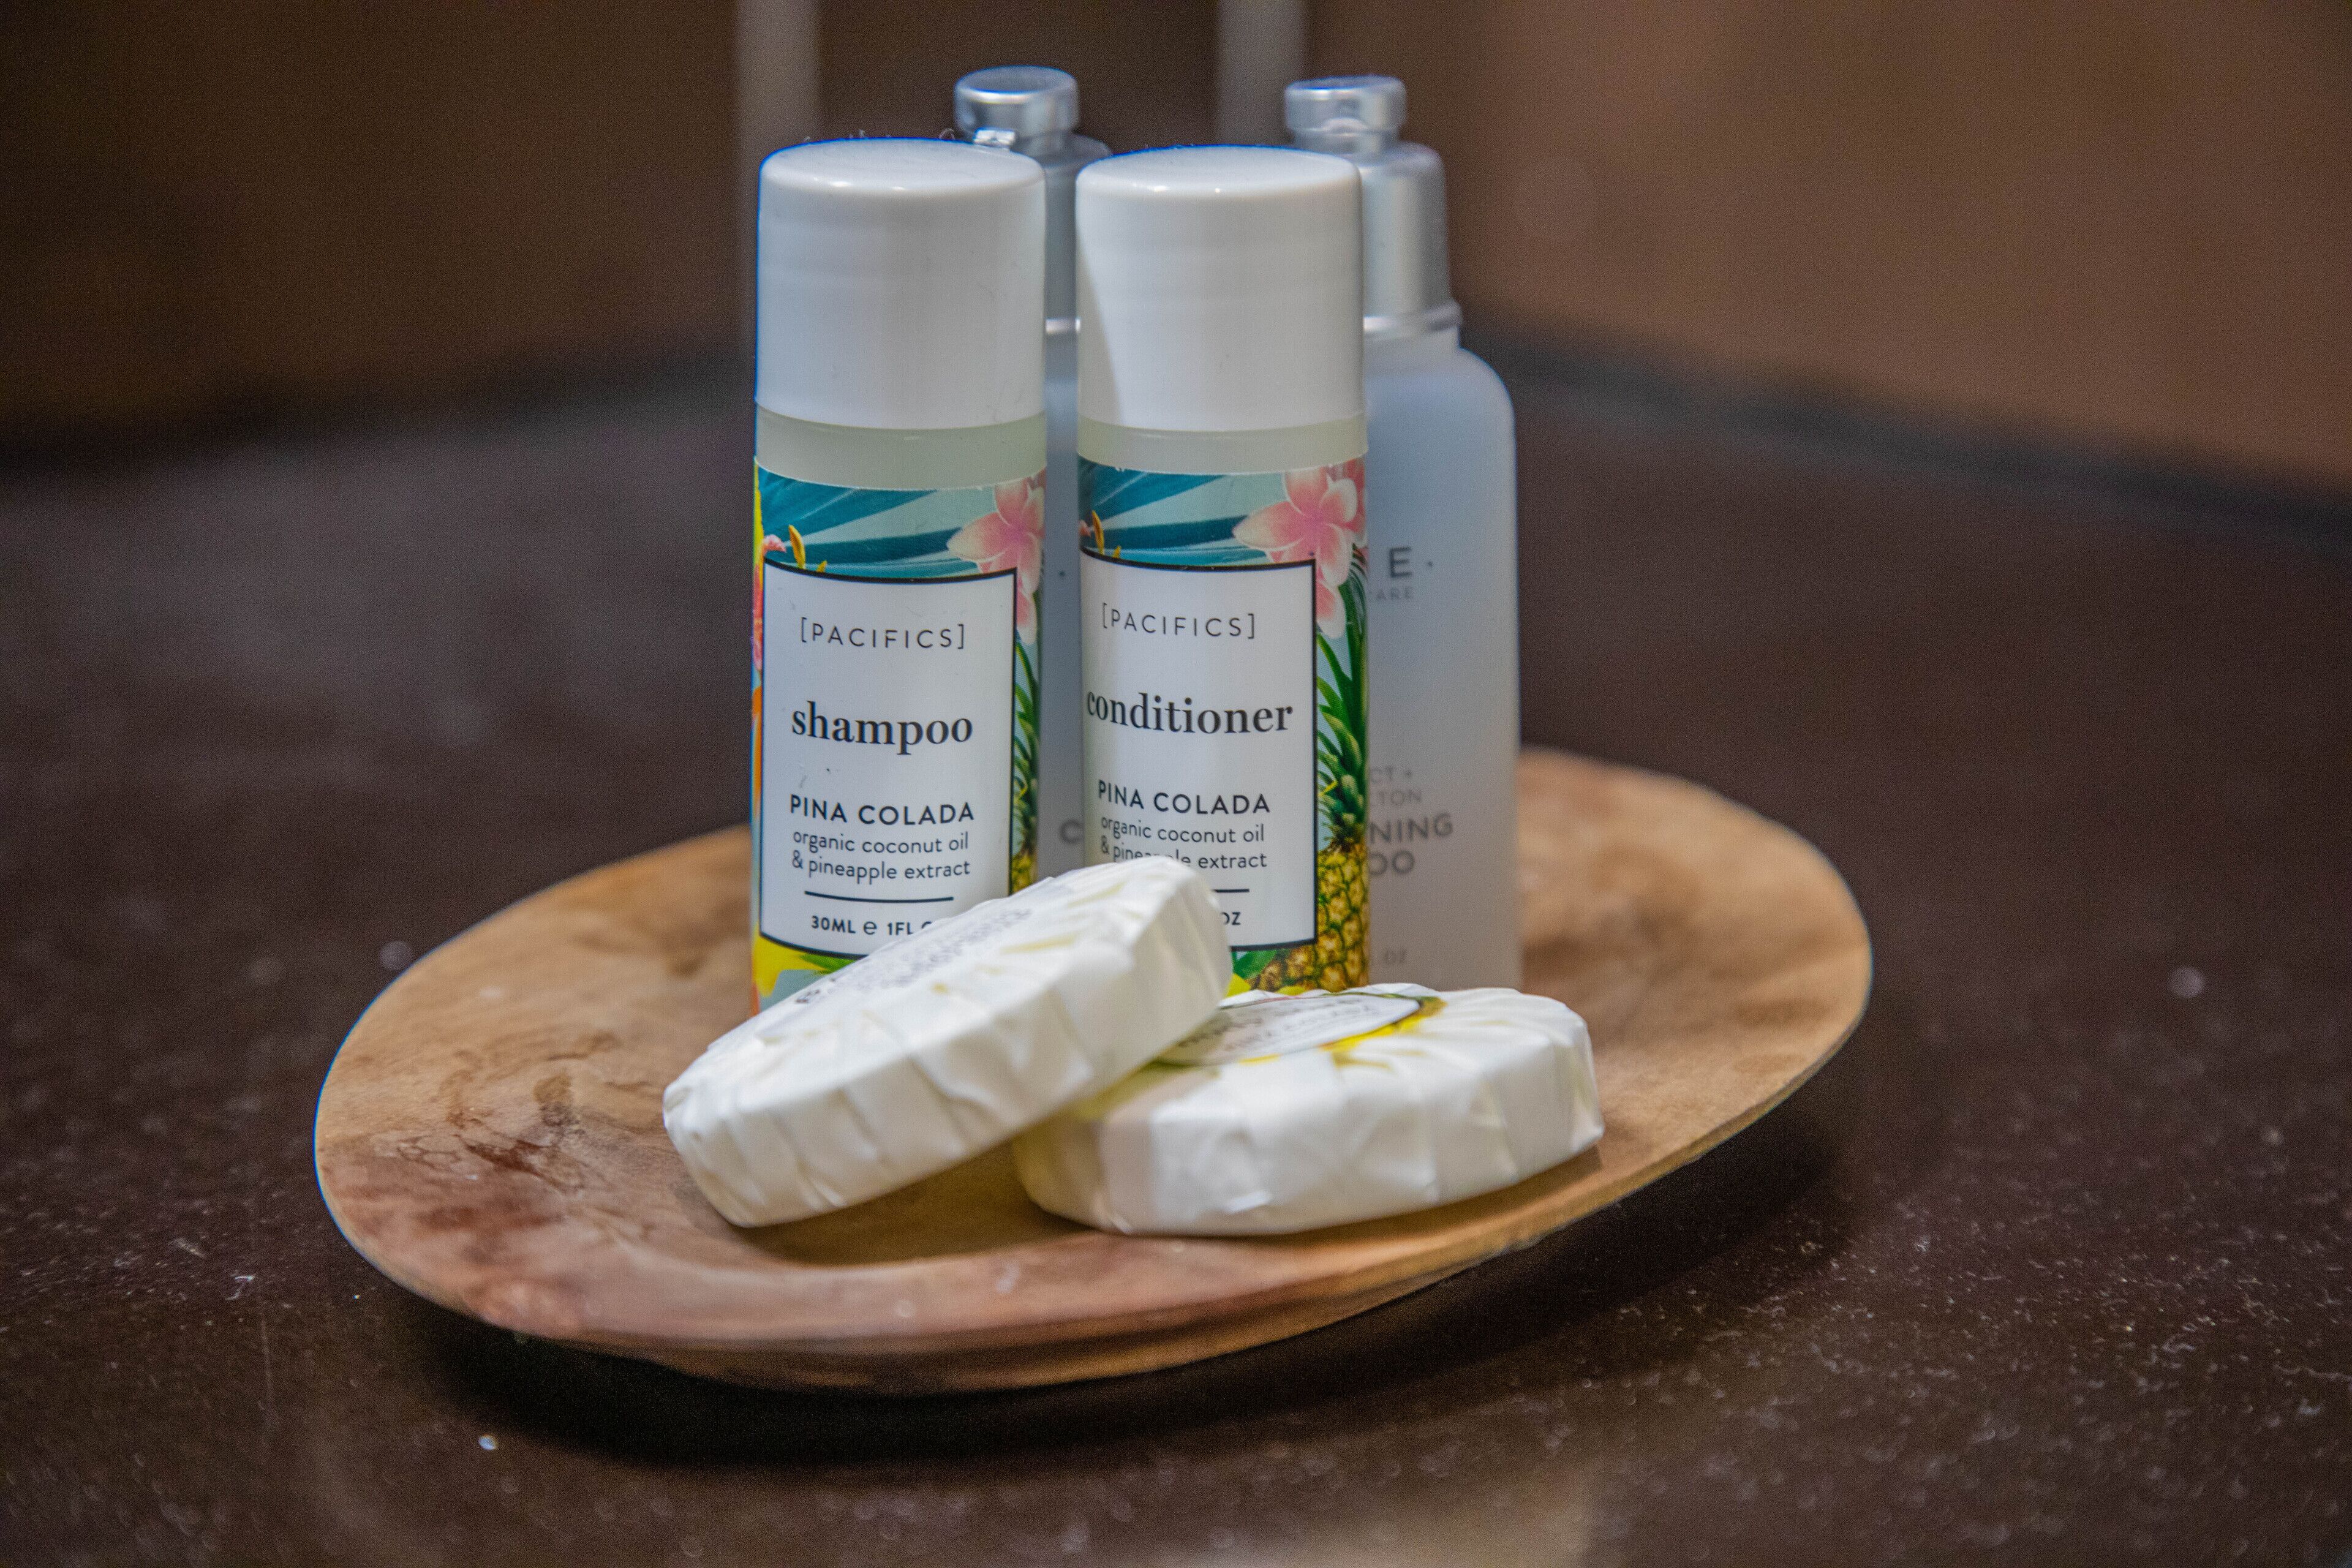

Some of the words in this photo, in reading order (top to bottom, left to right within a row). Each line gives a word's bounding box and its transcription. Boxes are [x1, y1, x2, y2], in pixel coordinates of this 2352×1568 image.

[800, 616, 965, 650] [PACIFICS]
[1102, 602, 1255, 640] [PACIFICS]
[791, 699, 973, 756] shampoo
[1087, 692, 1294, 734] conditioner
[790, 794, 847, 823] PINA
[858, 801, 974, 826] COLADA
[1098, 779, 1145, 810] PINA
[1153, 791, 1270, 815] COLADA
[792, 831, 855, 853] organic
[861, 839, 943, 854] coconut
[948, 831, 969, 851] oil
[1100, 816, 1152, 840] organic
[1157, 828, 1236, 843] coconut
[1242, 823, 1264, 843] oil
[791, 850, 804, 869] &
[808, 856, 897, 885] pineapple
[903, 861, 970, 880] extract
[1100, 834, 1110, 855] &
[1197, 853, 1267, 869] extract
[810, 915, 856, 934] 30ML
